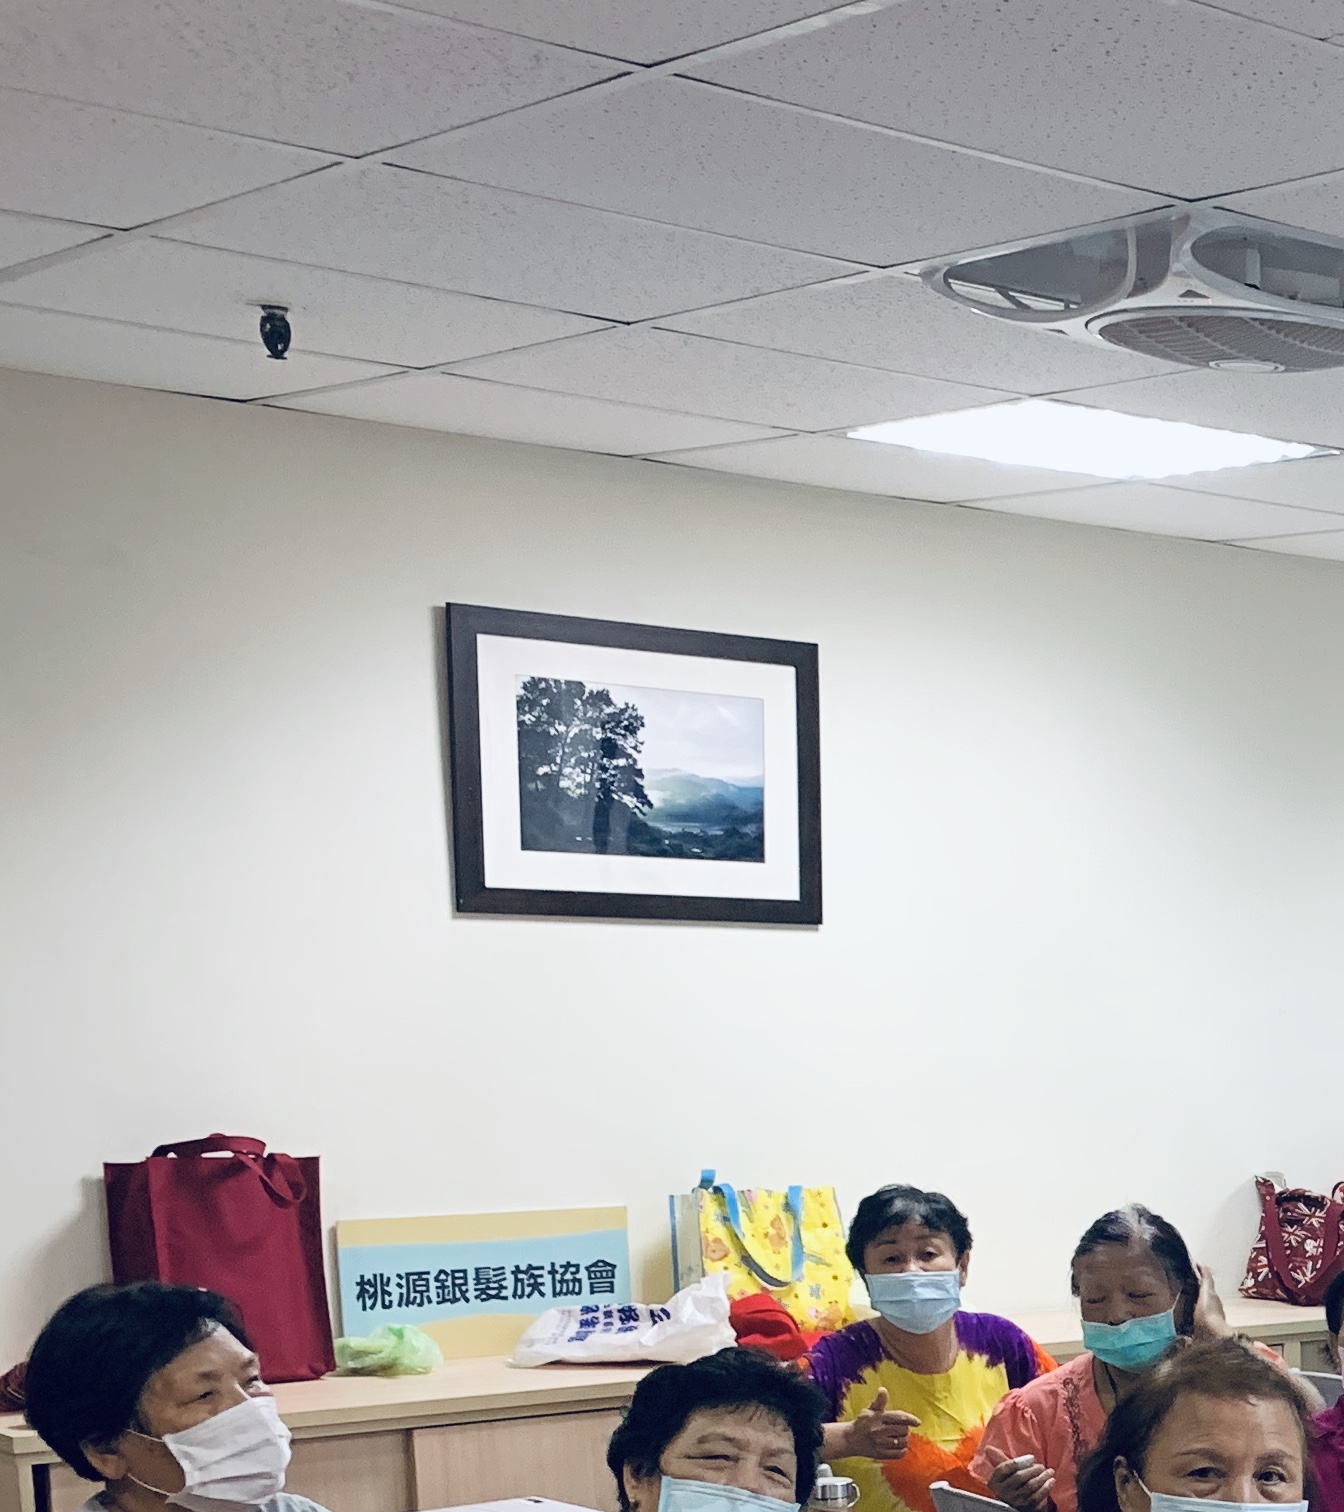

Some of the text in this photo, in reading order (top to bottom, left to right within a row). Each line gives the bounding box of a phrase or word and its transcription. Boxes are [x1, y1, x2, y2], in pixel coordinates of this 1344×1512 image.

[355, 1258, 617, 1312] 桃源銀髮族協會
